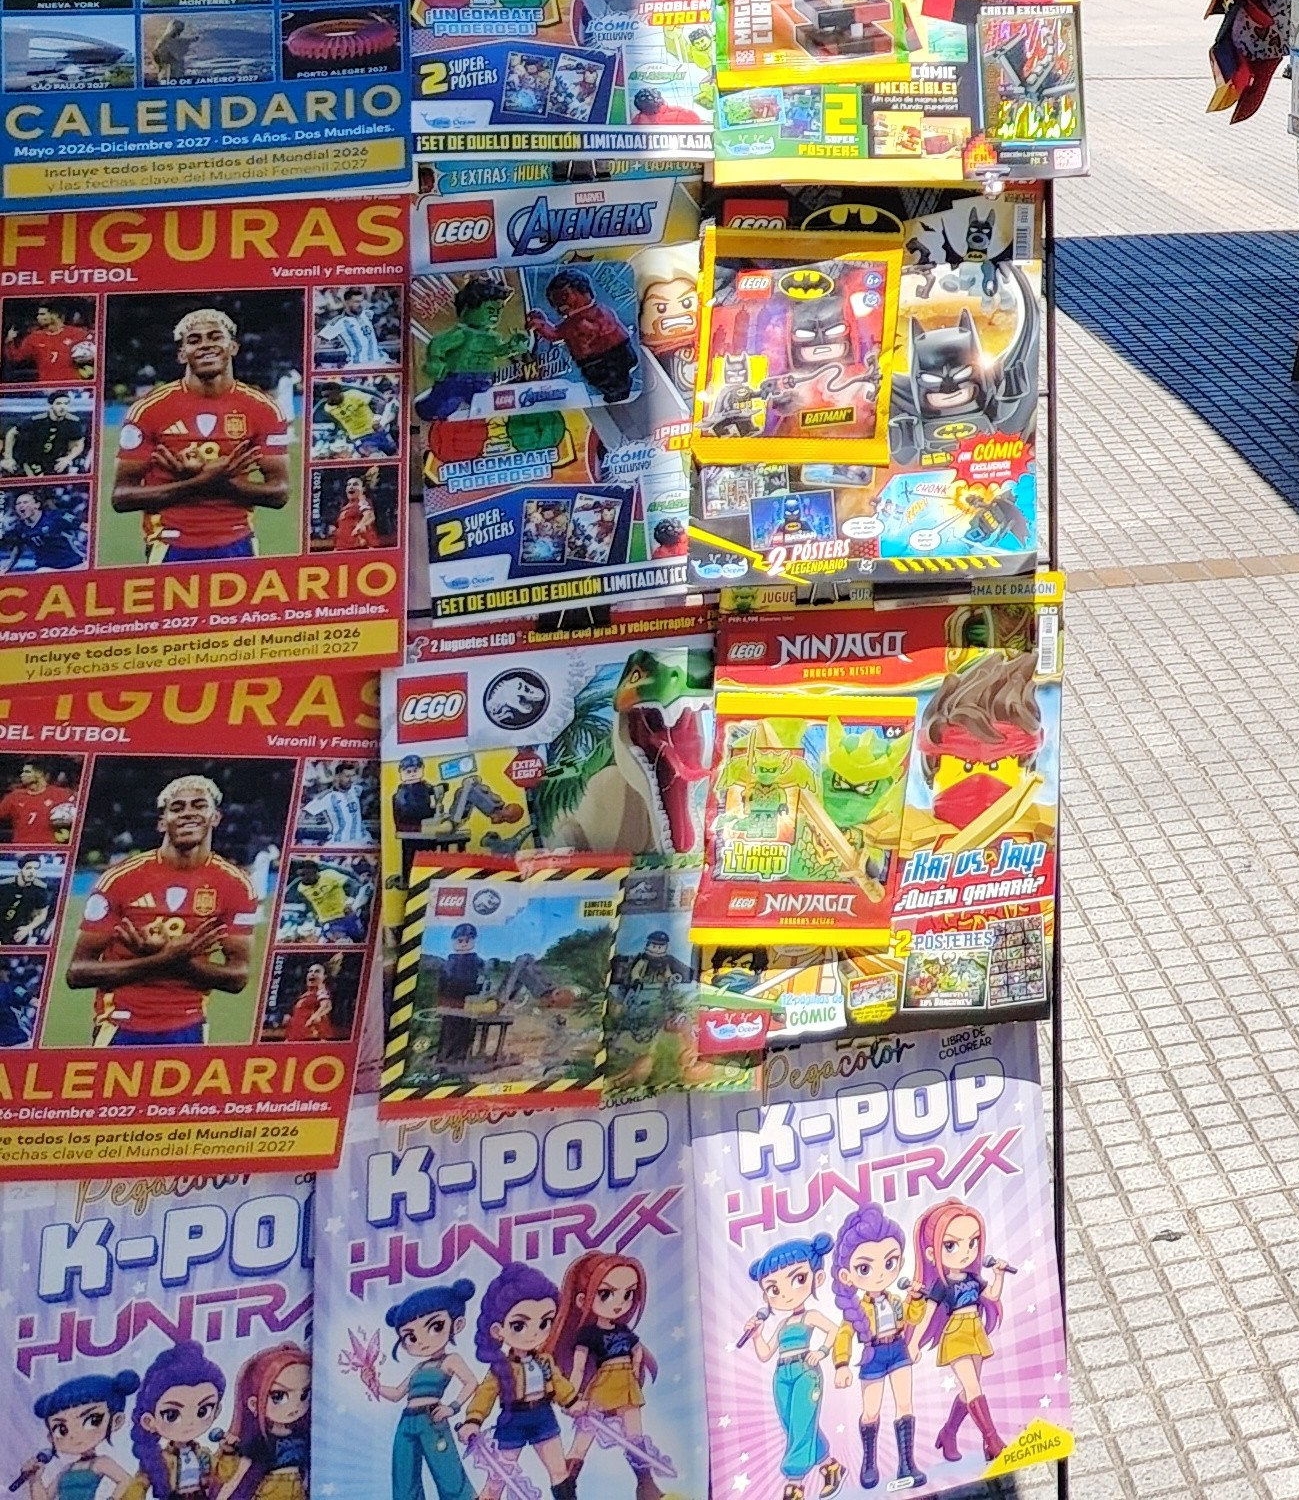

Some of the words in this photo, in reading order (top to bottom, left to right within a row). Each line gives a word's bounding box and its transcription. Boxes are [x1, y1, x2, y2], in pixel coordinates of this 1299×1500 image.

[37, 1, 71, 10] NUEVA
[73, 1, 100, 9] YORK
[425, 8, 460, 22] ¡UN
[461, 8, 543, 22] COMBATE
[1016, 5, 1073, 14] EXCLUSIVA
[434, 22, 536, 36] PODEROSO!
[419, 61, 449, 96] 2
[449, 57, 489, 75] SUPER-
[451, 68, 497, 91] PÓSTERS
[911, 63, 957, 79] CÓMIC
[874, 79, 957, 95] INCREÍBLE!
[5, 85, 402, 140] CALENDARIO
[825, 94, 857, 134] 2
[14, 144, 54, 159] Mayo
[58, 138, 175, 155] 2026-Diciembre
[177, 136, 211, 148] 2027
[222, 133, 249, 145] Dos
[251, 129, 292, 144] Años.
[294, 127, 323, 140] Dos
[324, 123, 395, 138] Mundiales.
[416, 134, 446, 151] ¡SET
[447, 134, 465, 150] DE
[467, 134, 510, 150] DUELO
[512, 134, 529, 150] DE
[531, 132, 581, 149] EDICIÓN
[583, 133, 646, 149] LIMITADA!
[798, 142, 859, 156] PÓSTERS
[44, 165, 99, 180] Incluye
[103, 162, 148, 175] todos
[152, 159, 174, 172] los
[177, 155, 241, 173] partidos
[246, 153, 269, 167] del
[272, 148, 329, 164] Mundial
[333, 146, 369, 159] 2026
[3, 204, 404, 267] FIGURAS
[431, 214, 493, 245] LEGO
[507, 195, 657, 257] AVENGERS
[1, 270, 45, 287] DEL
[50, 264, 138, 284] FÚTBOL
[272, 264, 321, 279] Varonil
[335, 263, 404, 276] Femenino
[866, 274, 880, 288] 6+
[739, 275, 769, 290] LEGO
[804, 410, 847, 425] BATMAN
[973, 440, 1023, 460] CÓMIC
[789, 558, 848, 575] LEGENDARIOS
[0, 561, 397, 624] CALENDARIO
[994, 584, 1009, 595] DE
[1010, 580, 1056, 595] DRAGÓN!
[25, 648, 81, 665] Incluye
[85, 644, 132, 659] todos
[135, 642, 159, 656] los
[162, 636, 229, 656] partidos
[233, 634, 257, 647] del
[260, 630, 320, 645] Mundial
[323, 627, 361, 640] 2026
[727, 643, 768, 660] LEGO
[771, 630, 912, 669] NINJAGO
[400, 691, 466, 724] LEGO
[512, 757, 543, 769] EXTRA
[734, 841, 789, 859] DRAGON
[723, 853, 789, 878] LLOYD
[762, 893, 857, 914] NINJAGO
[894, 930, 912, 958] 2
[789, 1007, 837, 1026] CÓMIC
[939, 1038, 993, 1061] COLOREAR
[736, 1057, 1006, 1180] K-POP
[365, 1110, 670, 1226] K-POP
[1018, 1430, 1043, 1448] CON
[1003, 1434, 1062, 1466] PEGATINAS
